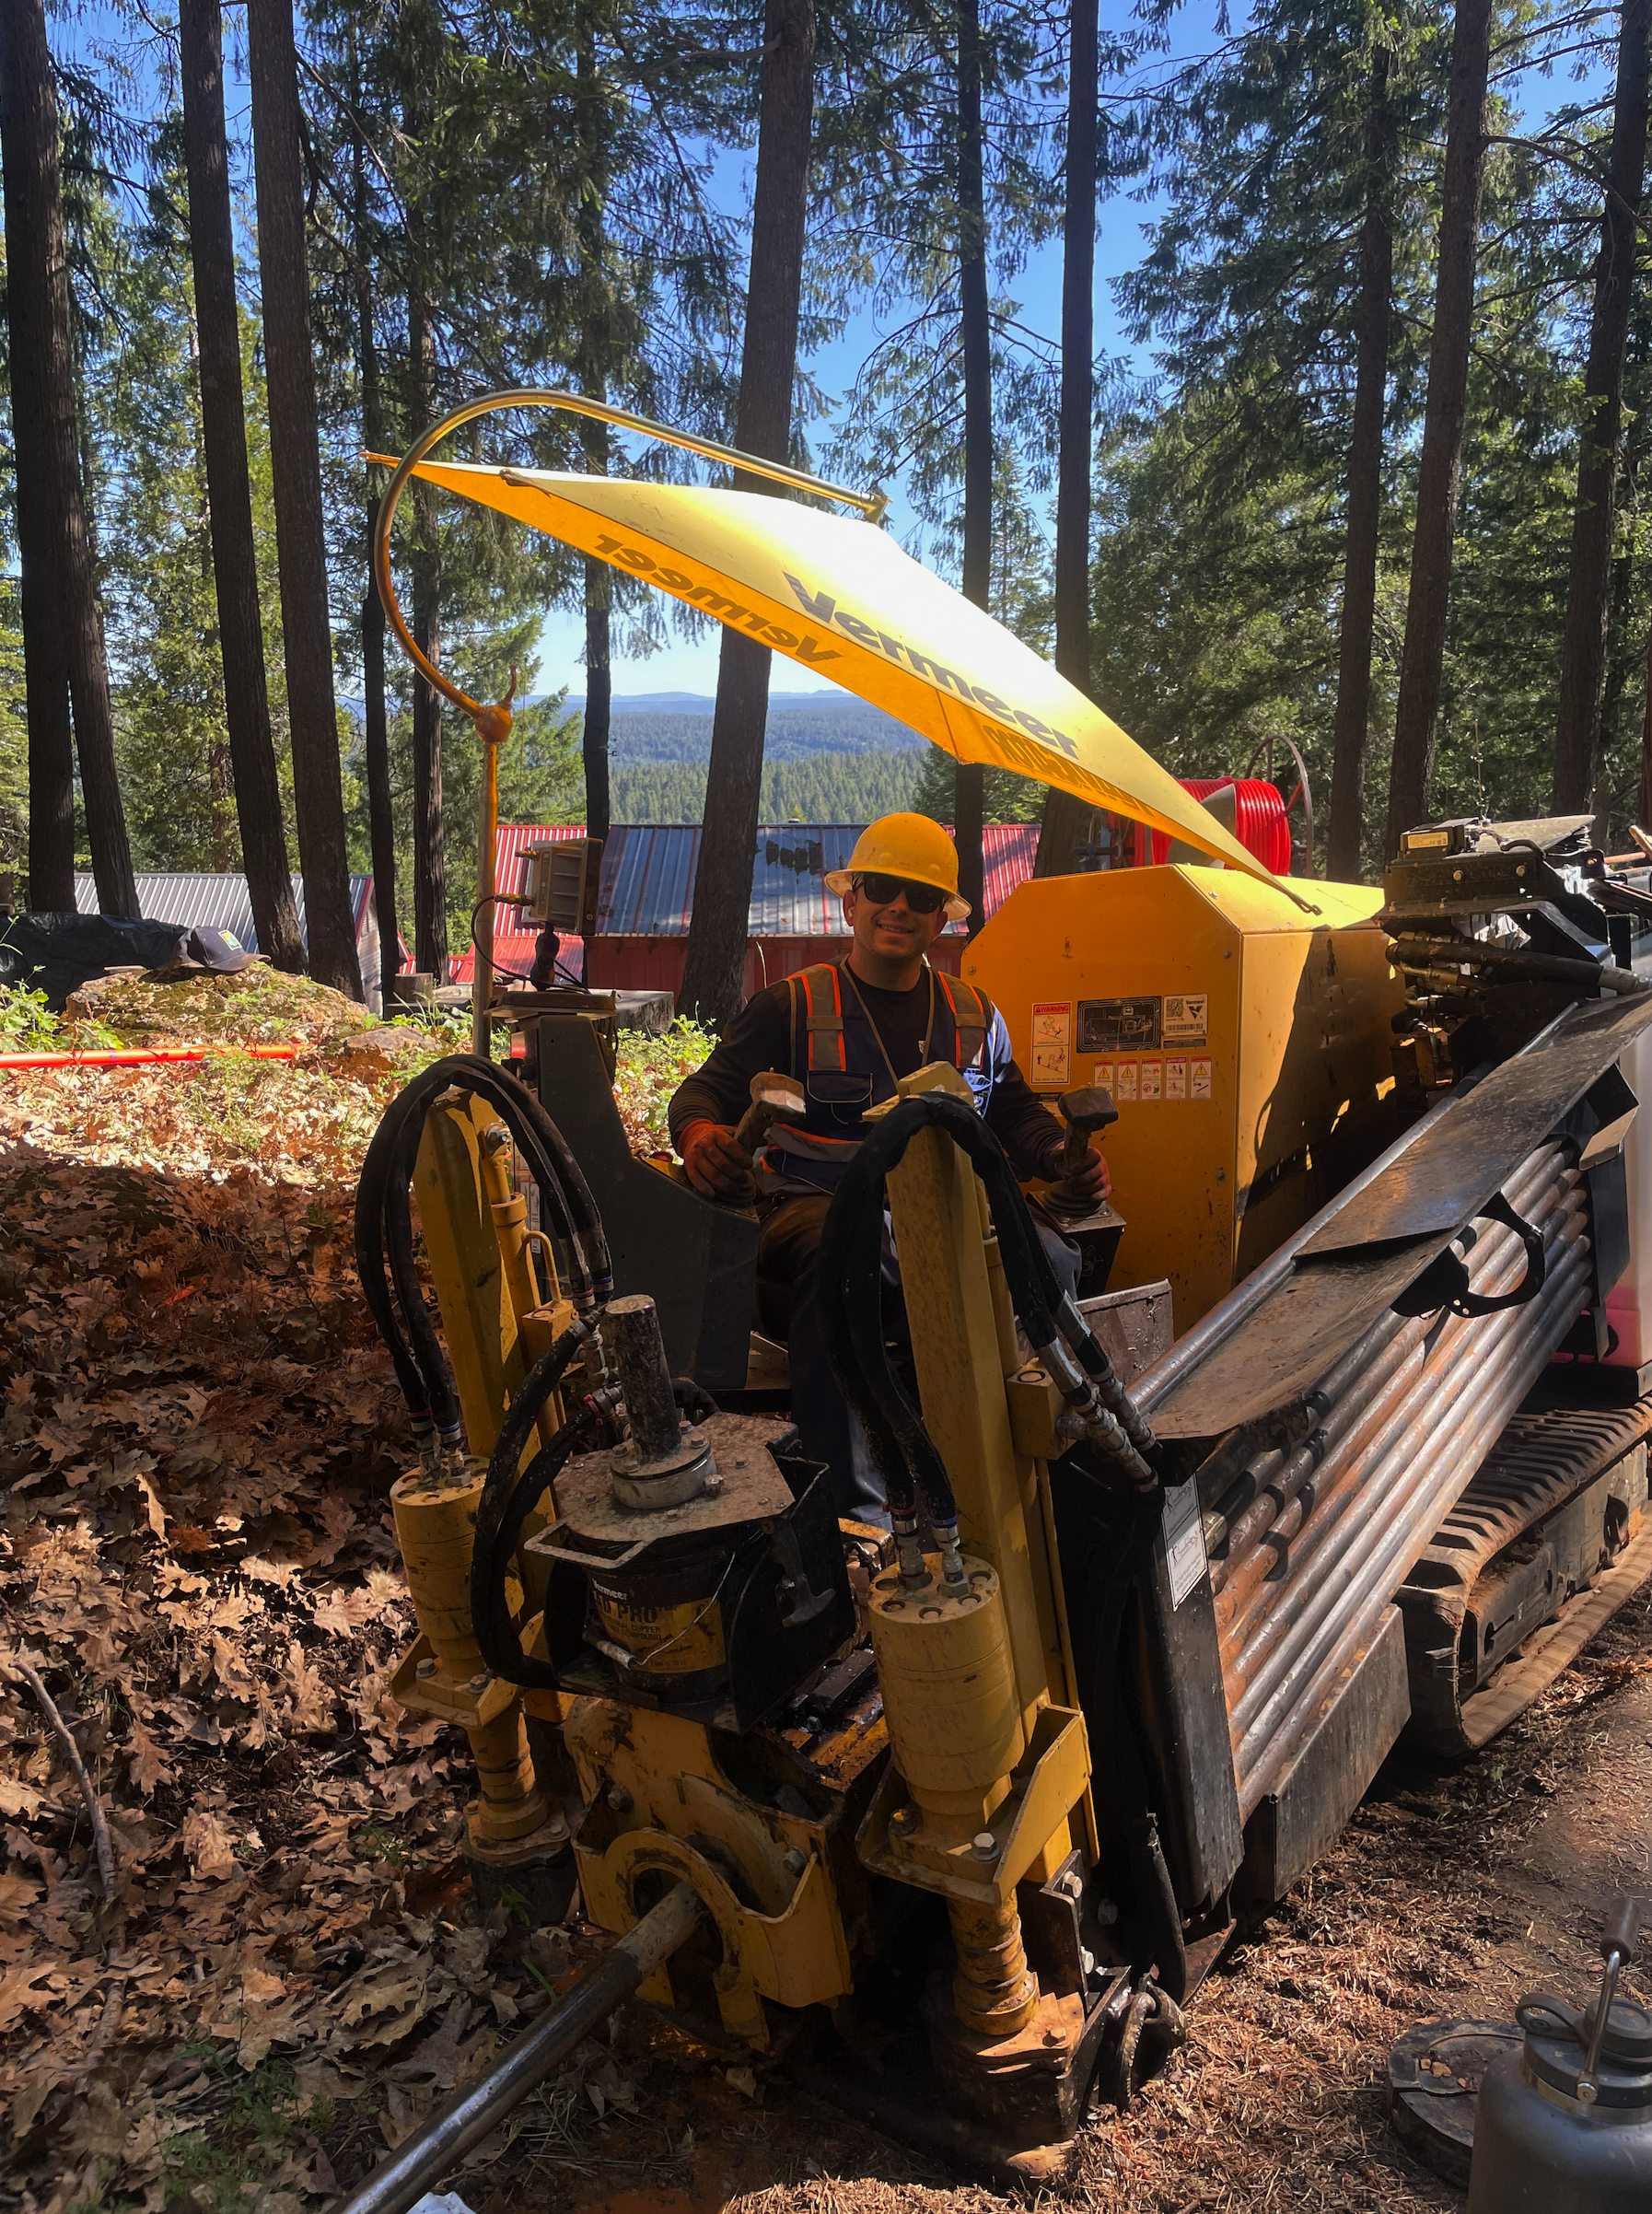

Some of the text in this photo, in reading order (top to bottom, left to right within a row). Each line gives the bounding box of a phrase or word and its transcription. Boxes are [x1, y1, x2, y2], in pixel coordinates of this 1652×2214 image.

[782, 570, 1080, 761] Vermeer
[591, 1578, 628, 1601] Vermeer
[618, 1602, 657, 1624] PRO
[631, 1625, 661, 1634] COPPER
